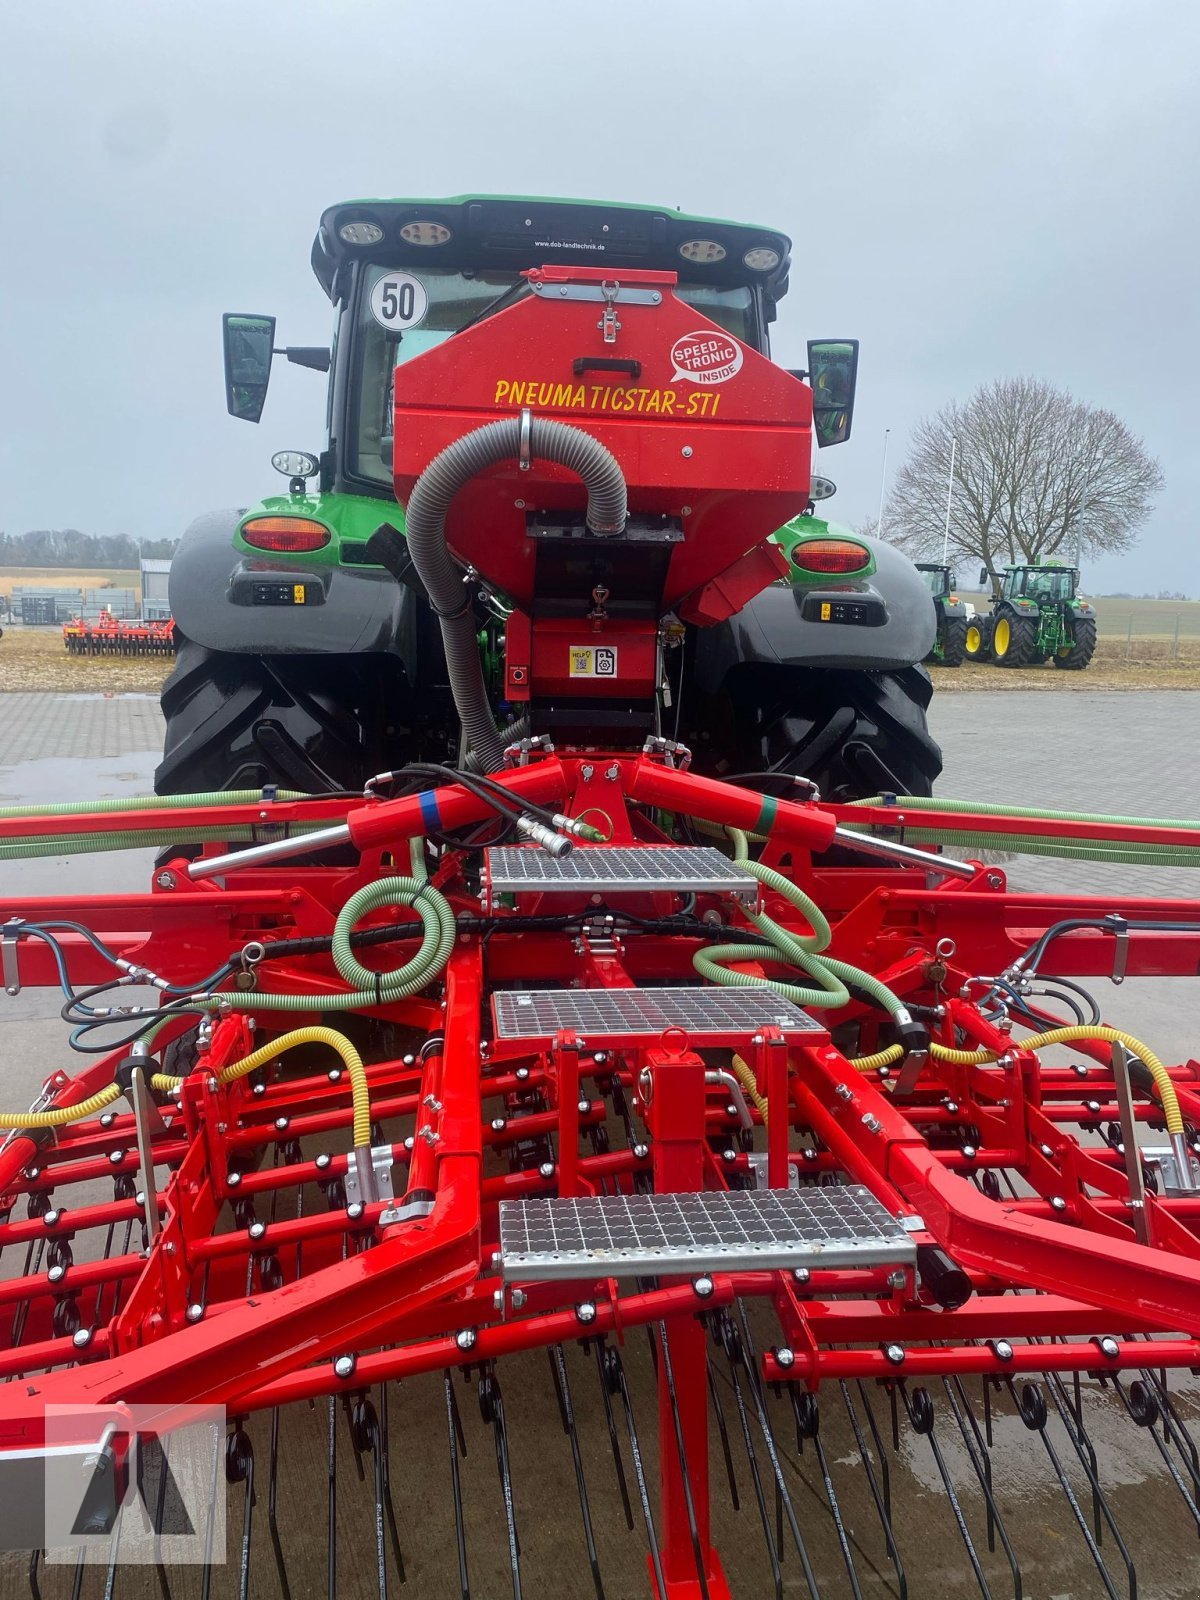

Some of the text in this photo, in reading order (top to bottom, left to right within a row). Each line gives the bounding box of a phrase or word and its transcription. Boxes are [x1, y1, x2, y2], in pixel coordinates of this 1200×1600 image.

[535, 241, 605, 250] www.dob-landtechnik.de
[382, 282, 414, 320] 50
[675, 340, 723, 360] SPEED-
[684, 348, 734, 370] TRONIC
[699, 364, 736, 382] INSIDE
